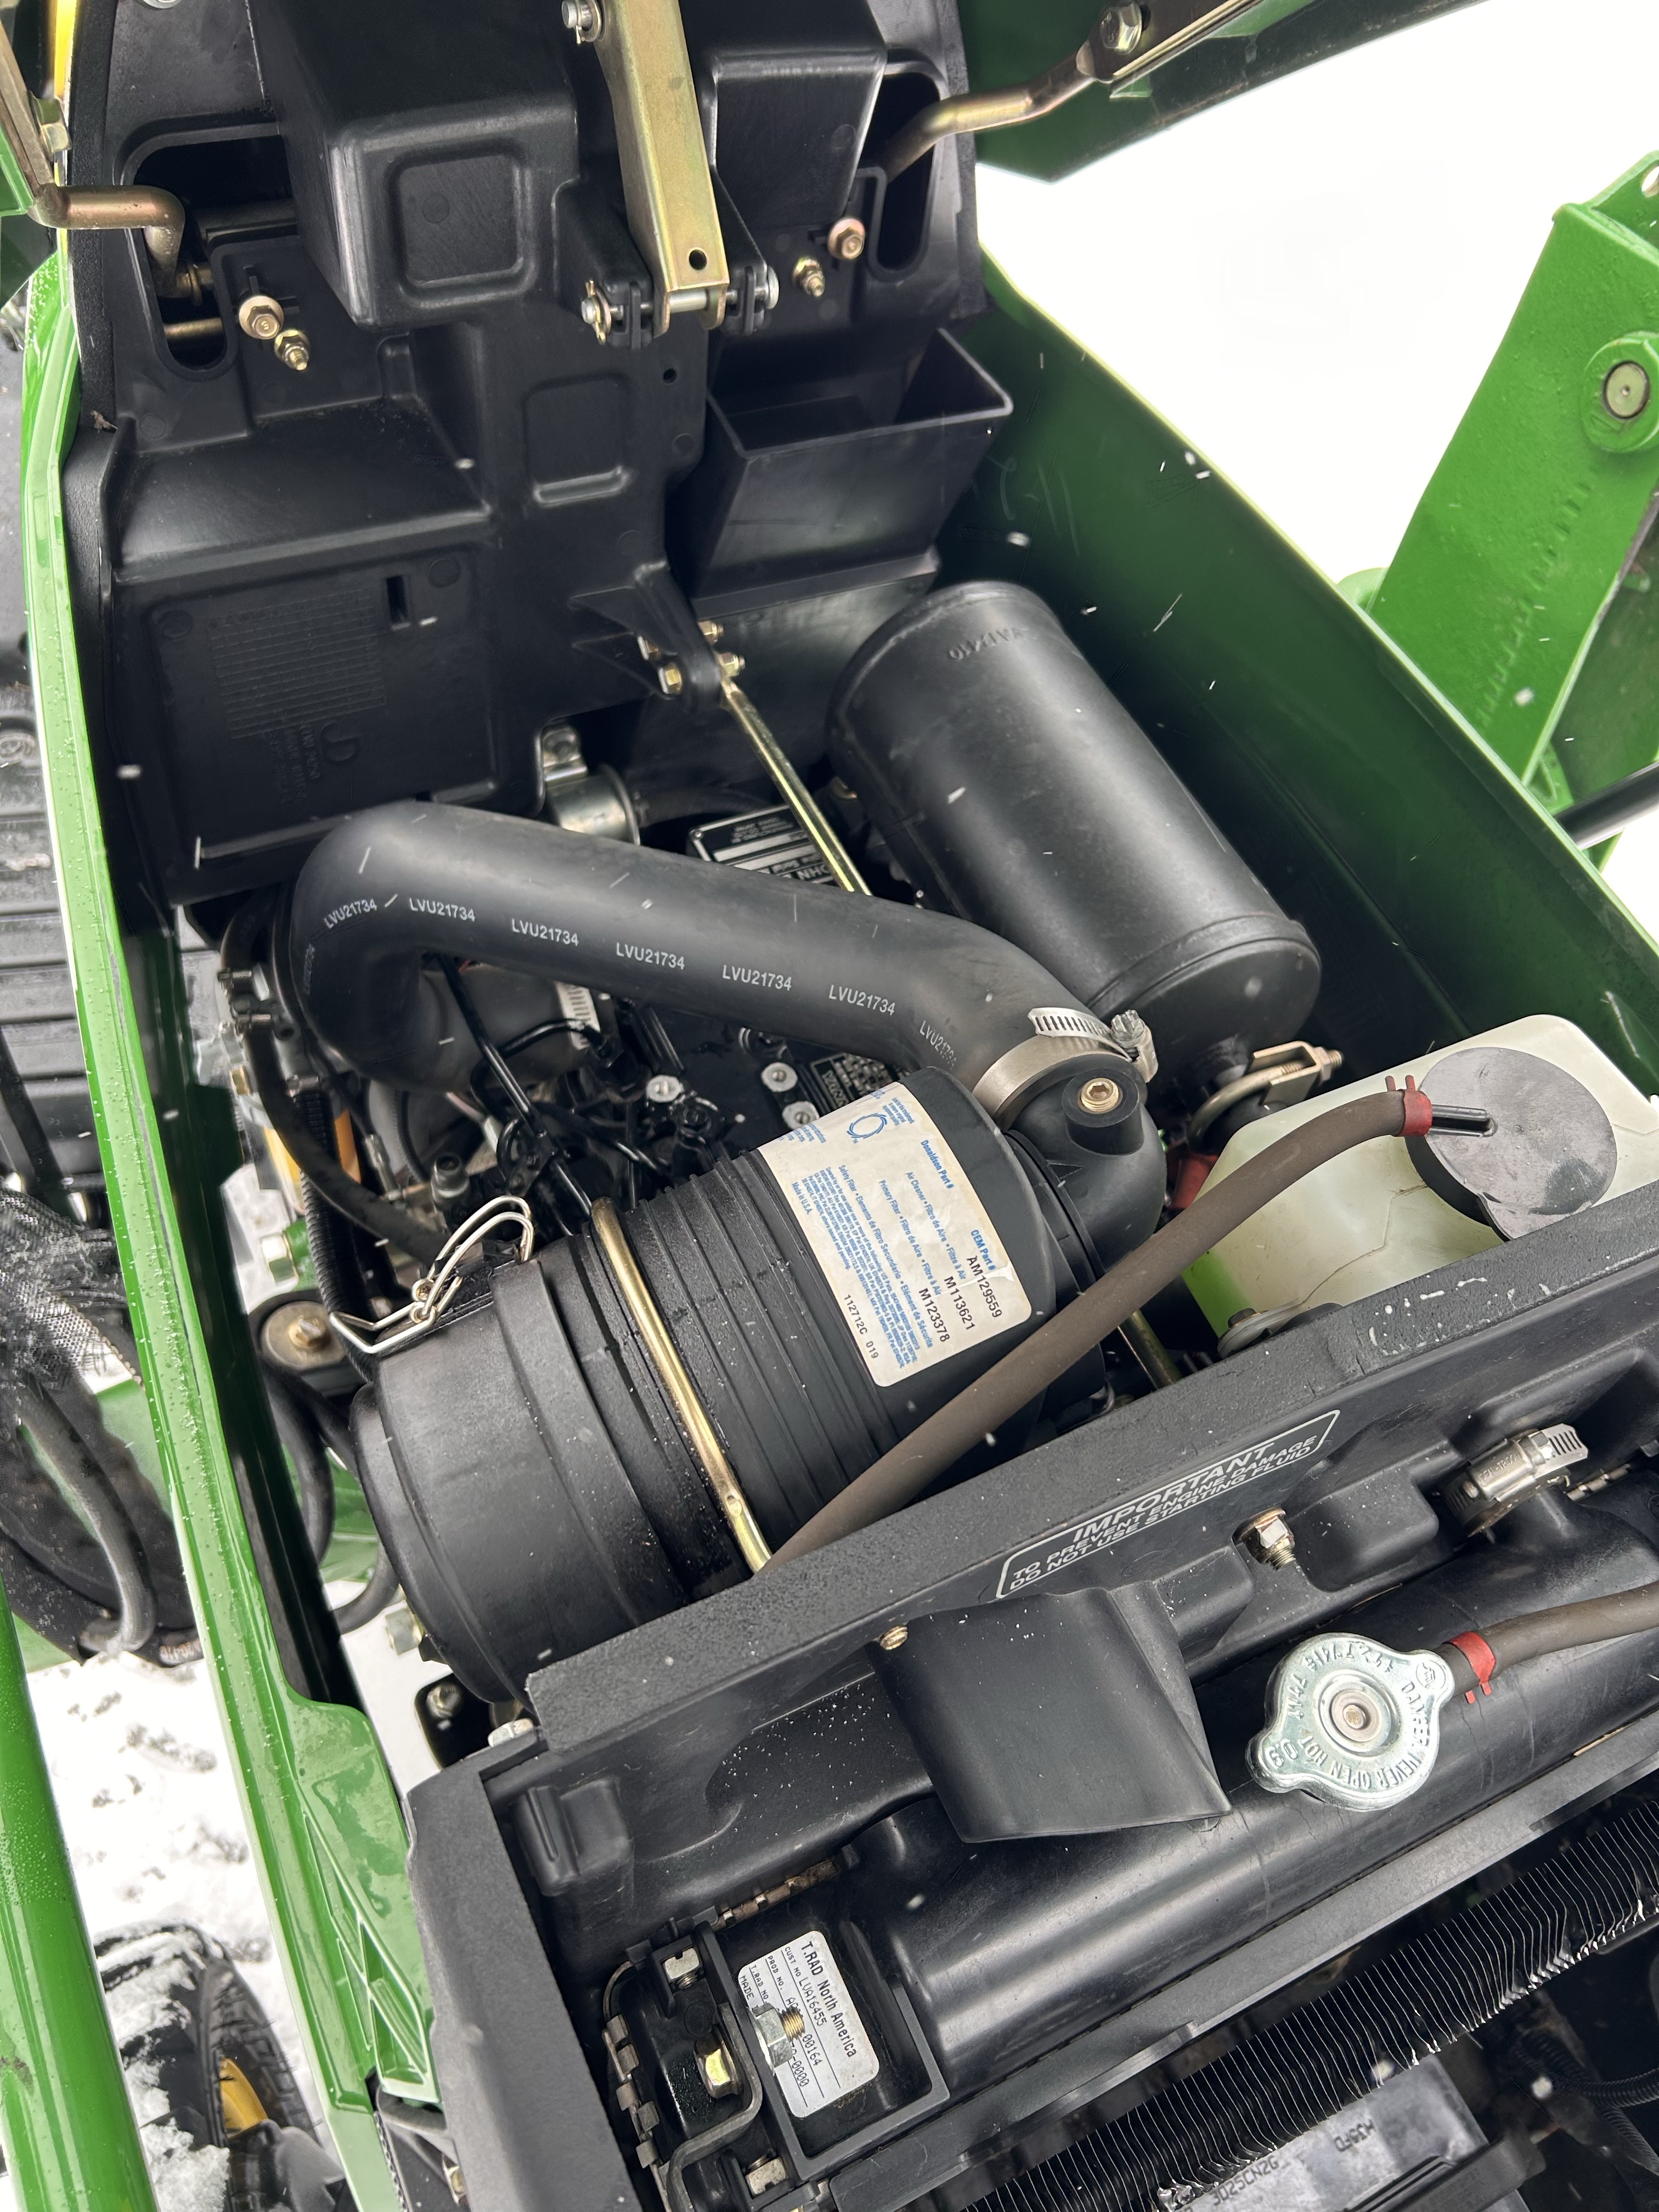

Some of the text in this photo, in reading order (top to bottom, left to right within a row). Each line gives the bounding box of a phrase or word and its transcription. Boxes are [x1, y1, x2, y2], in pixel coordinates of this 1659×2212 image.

[323, 898, 378, 929] LVU21734
[409, 898, 476, 922] LVU21734
[511, 918, 579, 947] LVU21734
[616, 941, 685, 970] LVU21734
[722, 964, 793, 991] LVU21734
[828, 984, 896, 1016] LVU21734
[921, 1140, 942, 1171] Donaldson
[938, 1170, 951, 1184] Part
[792, 1182, 802, 1195] Made
[911, 1180, 926, 1200] Cleaner
[826, 1167, 836, 1180] Covered
[844, 1201, 853, 1212] under
[881, 1272, 888, 1280] US
[924, 1204, 935, 1220] Filtro
[933, 1220, 940, 1228] de
[838, 1165, 850, 1180] Safety
[847, 1179, 856, 1192] Filter
[855, 1195, 872, 1221] Elemento
[873, 1228, 884, 1244] Filtro
[881, 1244, 901, 1279] Secundario
[913, 1311, 921, 1320] de
[878, 1180, 893, 1200] Primary
[890, 1200, 901, 1214] Filter
[900, 1219, 911, 1235] Filtro
[908, 1235, 915, 1244] de
[912, 1244, 922, 1257] Aire
[922, 1263, 933, 1279] Filtre
[932, 1286, 941, 1295] Air
[936, 1229, 946, 1242] Aire
[971, 1230, 985, 1248] OEM
[980, 1248, 992, 1265] Part
[946, 1247, 958, 1264] Filtre
[957, 1270, 966, 1279] Air
[967, 1256, 1002, 1317] AM129559
[918, 1288, 950, 1342] M123378
[944, 1276, 975, 1330] M113621
[844, 1294, 867, 1334] 112712C
[866, 1341, 879, 1358] 019
[1013, 1435, 1317, 1578] TO PREVENT ENGINE DAMAGE
[1073, 1442, 1275, 1542] IMPORTANT
[1009, 1446, 1311, 1590] DO NOT USE STARTING FLUID
[1264, 1738, 1299, 1769] 0.9
[1298, 1735, 1328, 1767] HOT
[1330, 1760, 1372, 1790] OPEN
[1376, 1752, 1423, 1788] NEVER
[739, 1975, 755, 2000] MADE
[751, 1963, 764, 1987] T.RAD
[767, 1955, 779, 1974] PROD
[776, 1976, 785, 1991] NO.
[783, 1946, 828, 2027] CUST NO LVA16455
[801, 1941, 857, 2058] T.RAD North America
